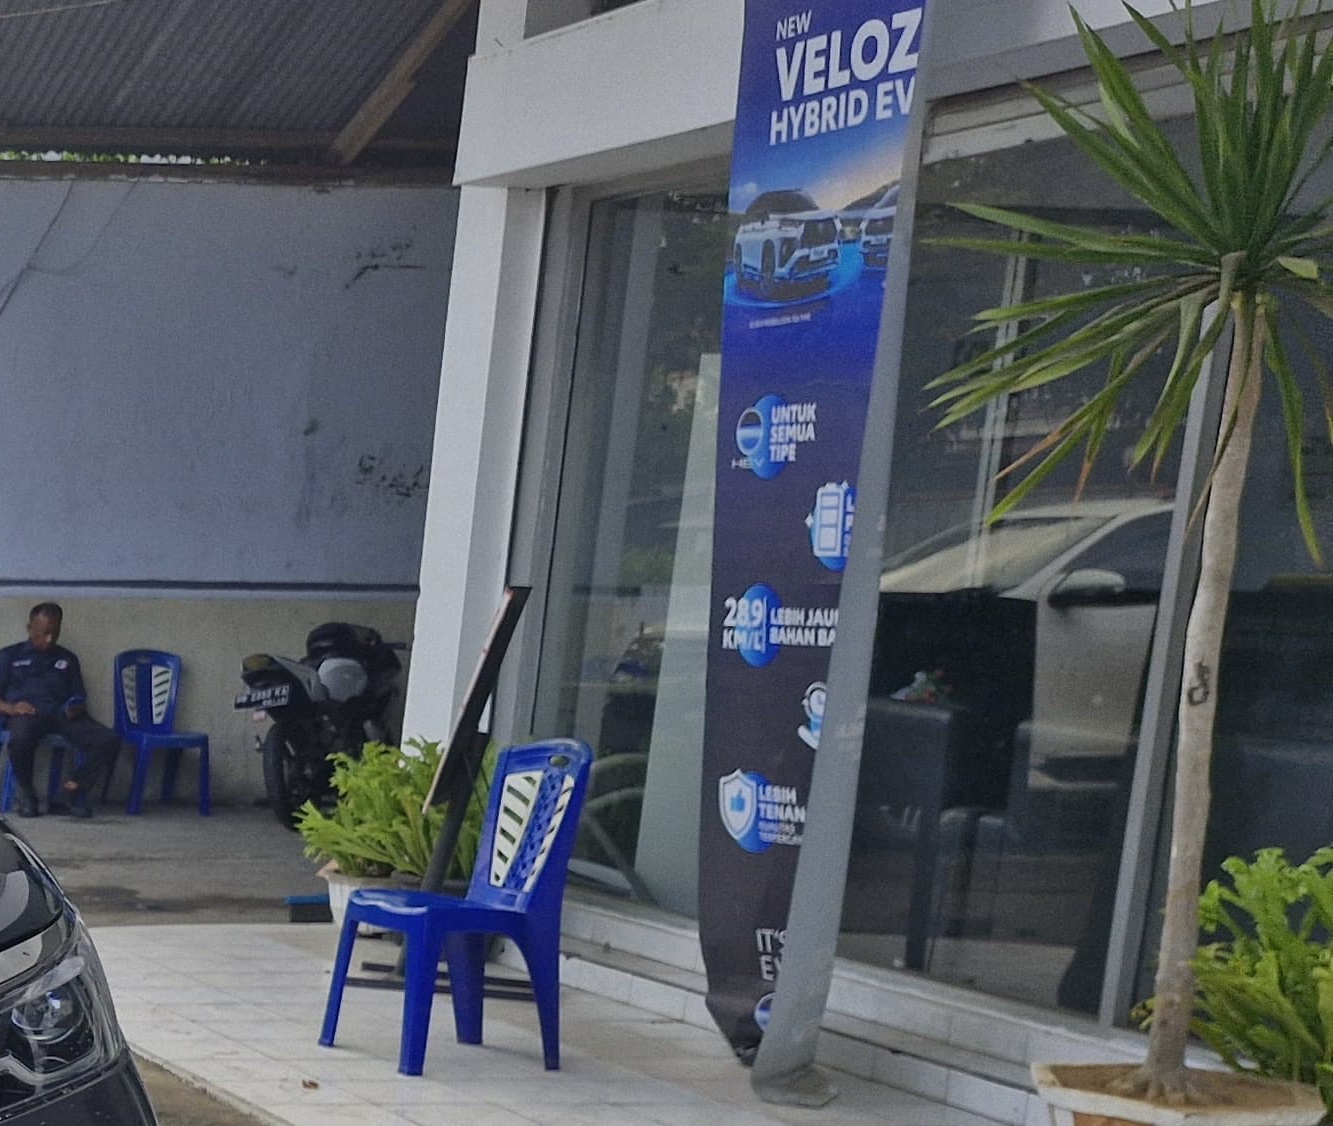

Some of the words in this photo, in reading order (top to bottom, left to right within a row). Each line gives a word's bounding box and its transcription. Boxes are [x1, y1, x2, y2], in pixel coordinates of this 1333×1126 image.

[776, 10, 812, 41] NEW
[775, 8, 923, 102] VELOZ
[769, 89, 869, 146] HYBRID
[875, 76, 916, 121] EV
[771, 402, 817, 423] UNTUK
[770, 422, 816, 443] SEMUA
[769, 443, 796, 462] TIPE
[770, 607, 806, 627] LEBIH
[806, 608, 839, 627] JAU
[769, 627, 816, 646] BAHAN
[757, 784, 797, 804] LEBIH
